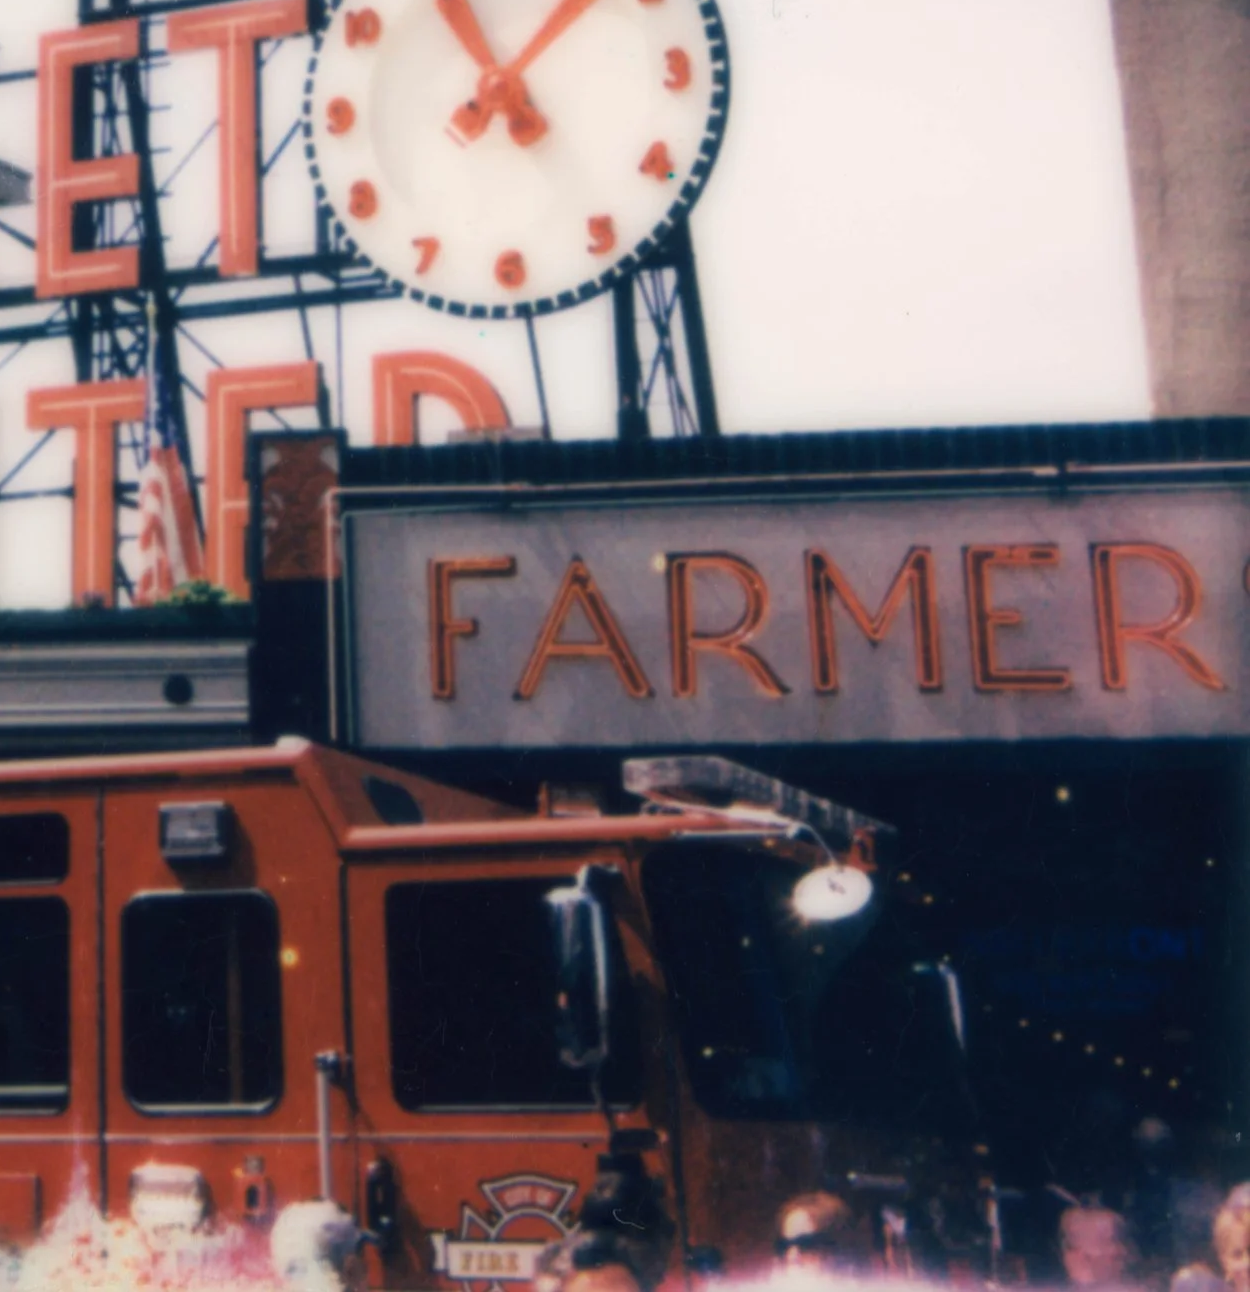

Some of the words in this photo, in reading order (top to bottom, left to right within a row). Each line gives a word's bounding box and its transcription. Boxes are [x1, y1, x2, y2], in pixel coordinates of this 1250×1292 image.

[344, 8, 382, 48] 10
[663, 46, 692, 92] 3
[326, 96, 357, 137] 9
[638, 140, 675, 184] 4
[348, 179, 379, 220] 8
[586, 214, 617, 256] 5
[411, 236, 442, 276] 7
[494, 249, 526, 290] 6
[425, 540, 1250, 701] FARMER
